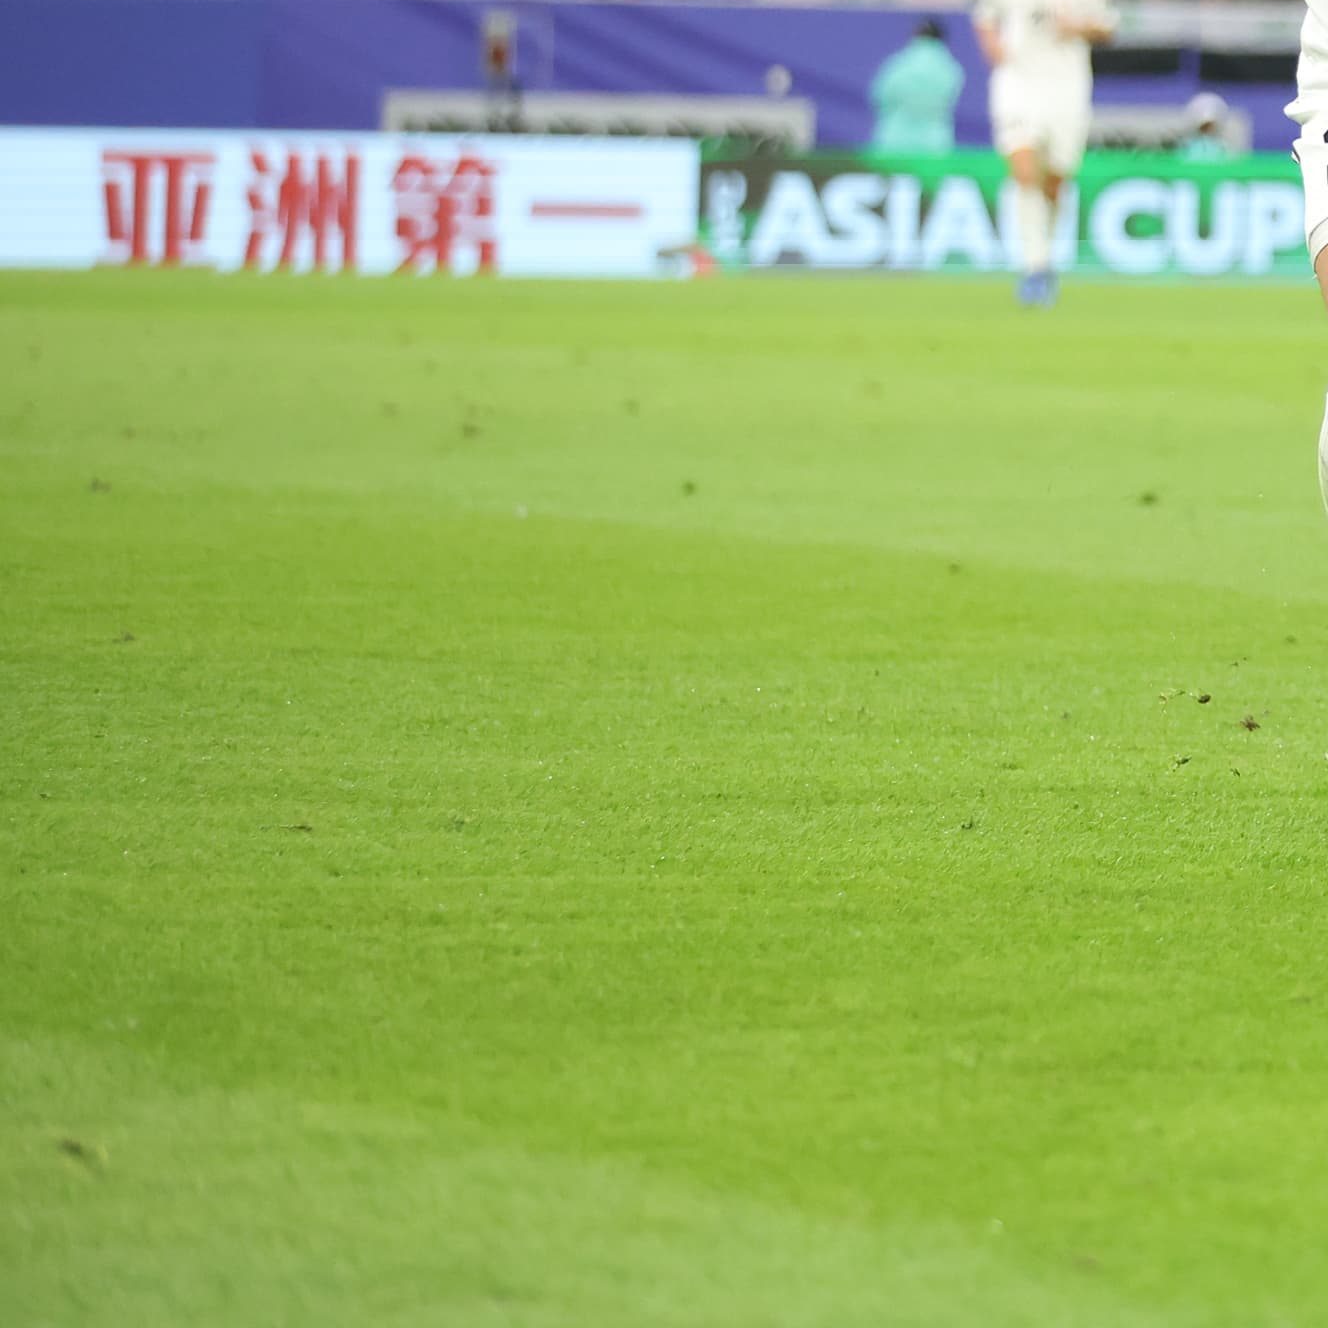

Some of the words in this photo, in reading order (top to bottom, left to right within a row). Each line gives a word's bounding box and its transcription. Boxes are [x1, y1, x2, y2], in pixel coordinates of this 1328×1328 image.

[100, 144, 645, 272] 亚洲第一
[1088, 176, 1305, 275] CUP
